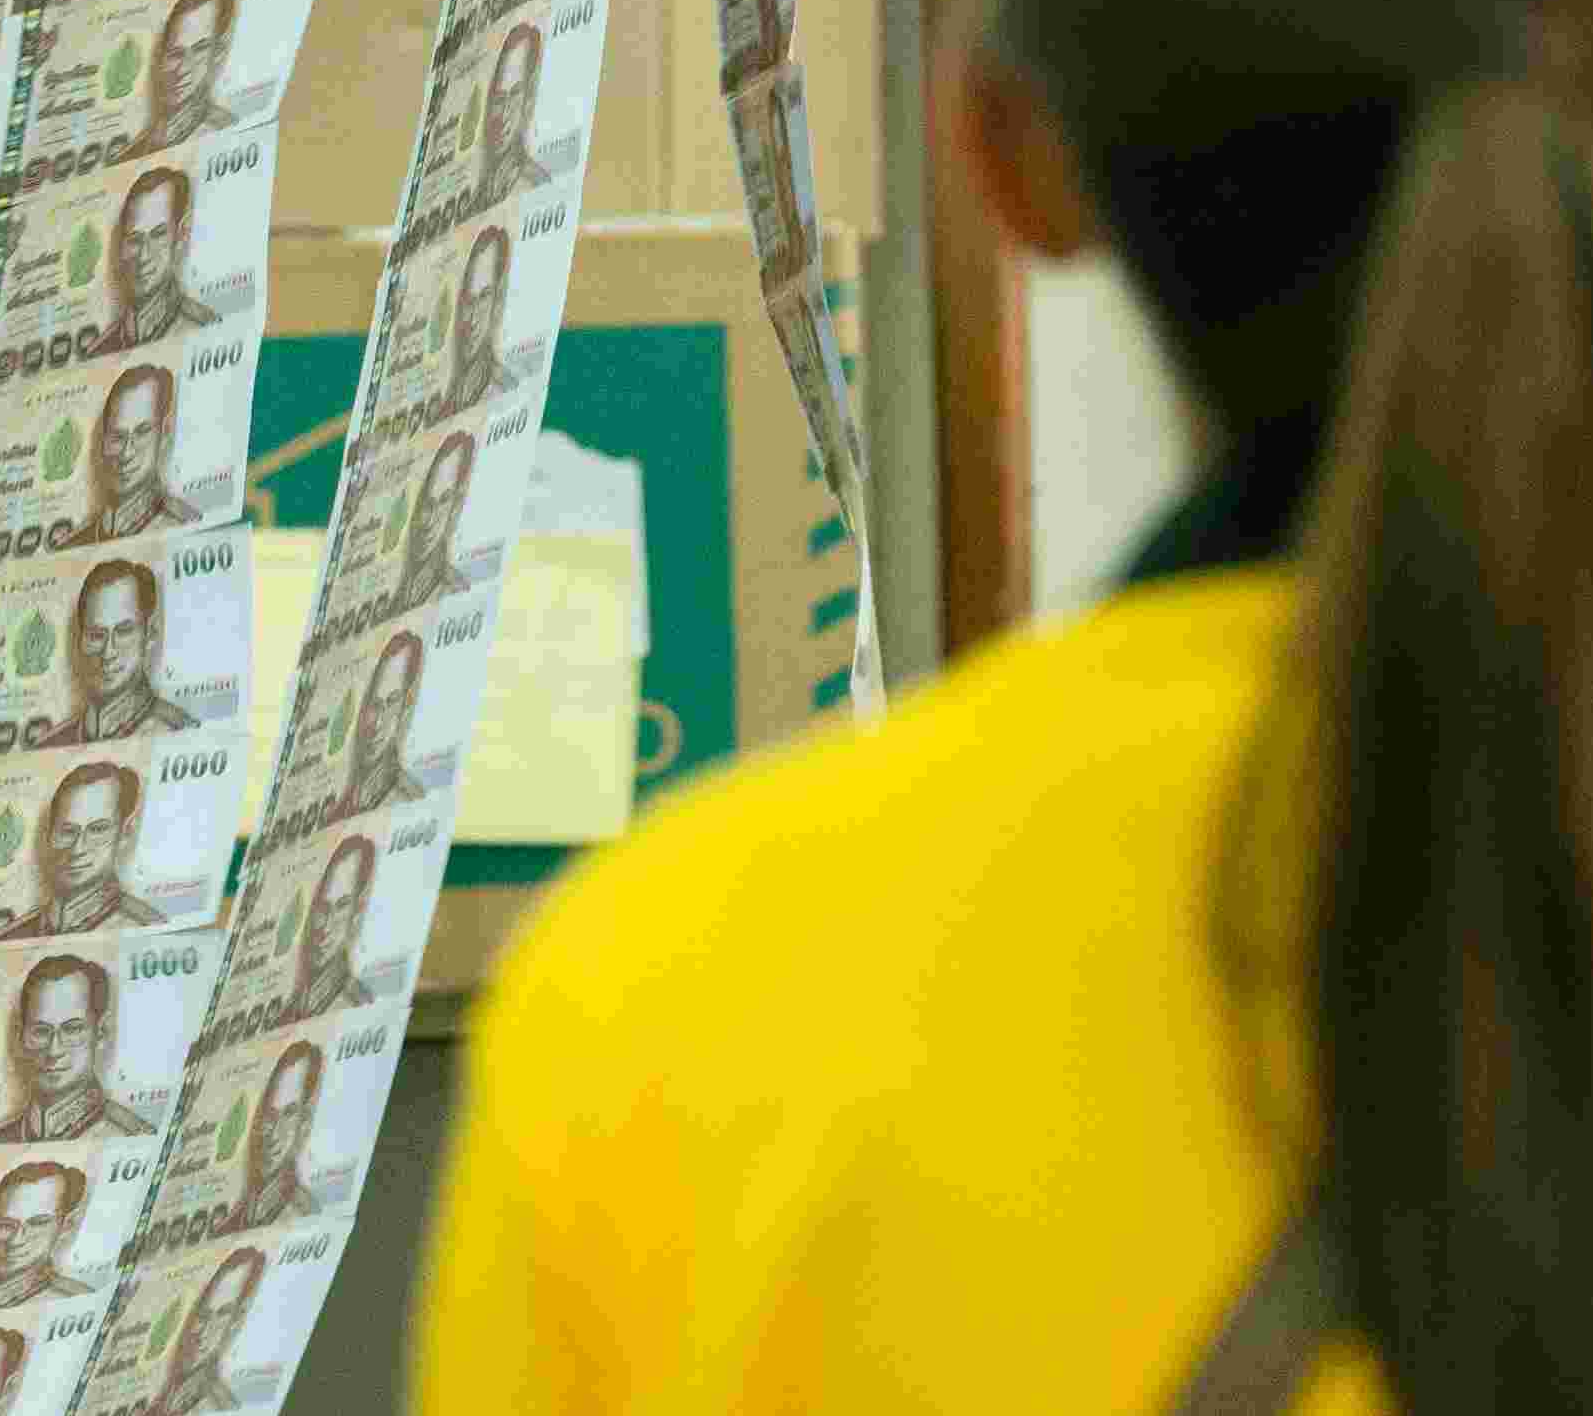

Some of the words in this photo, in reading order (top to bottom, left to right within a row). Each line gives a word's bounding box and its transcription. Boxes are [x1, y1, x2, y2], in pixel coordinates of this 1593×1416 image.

[205, 144, 258, 181] 1000
[521, 203, 567, 242] 1000
[189, 342, 243, 378] 1000
[487, 407, 529, 448] 1000
[171, 545, 233, 579] 1000
[434, 609, 484, 650] 1000
[159, 752, 228, 785] 1000
[388, 819, 438, 856] 1000
[128, 948, 199, 981] 1000
[335, 1024, 387, 1062] 1000
[278, 1232, 331, 1267] 1000
